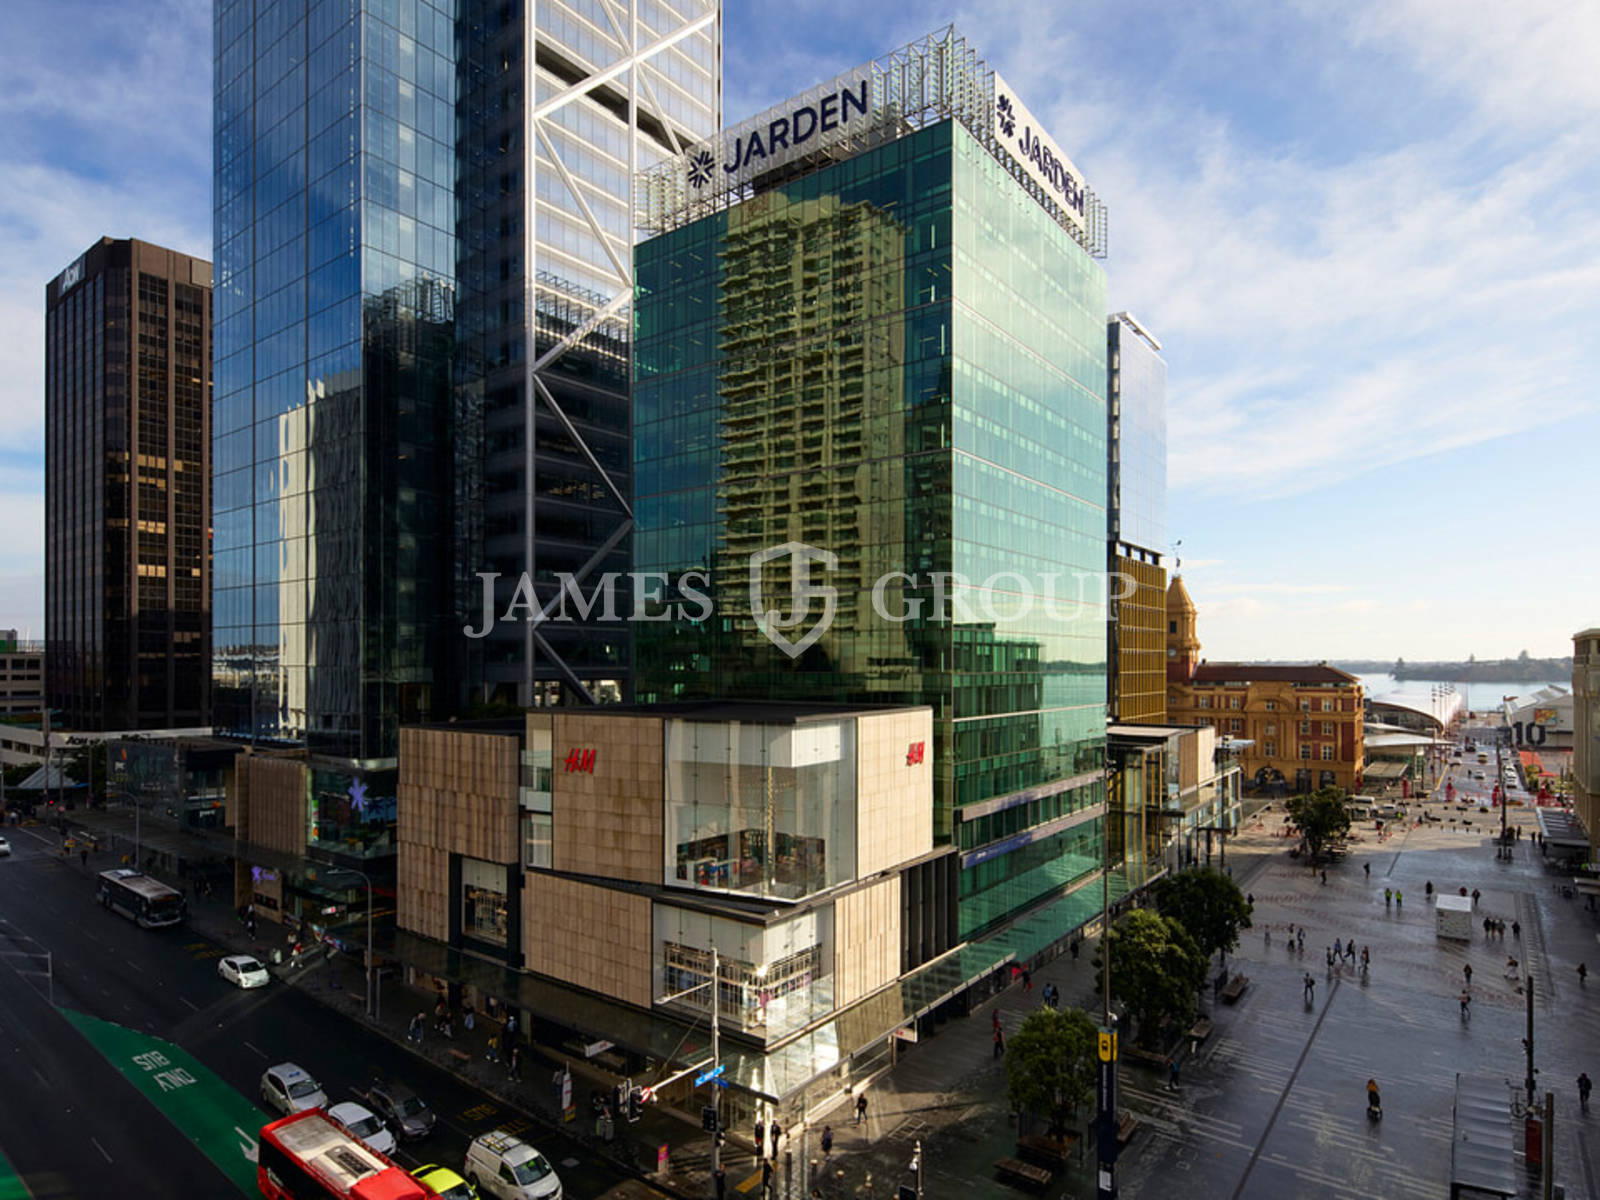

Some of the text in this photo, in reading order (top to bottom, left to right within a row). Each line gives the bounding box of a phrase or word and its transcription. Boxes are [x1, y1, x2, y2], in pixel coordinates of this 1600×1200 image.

[723, 79, 868, 174] JARDEN
[1018, 125, 1084, 217] JARDEN
[564, 747, 596, 775] H&M
[131, 1050, 171, 1071] BUS
[152, 1067, 197, 1092] ONLY
